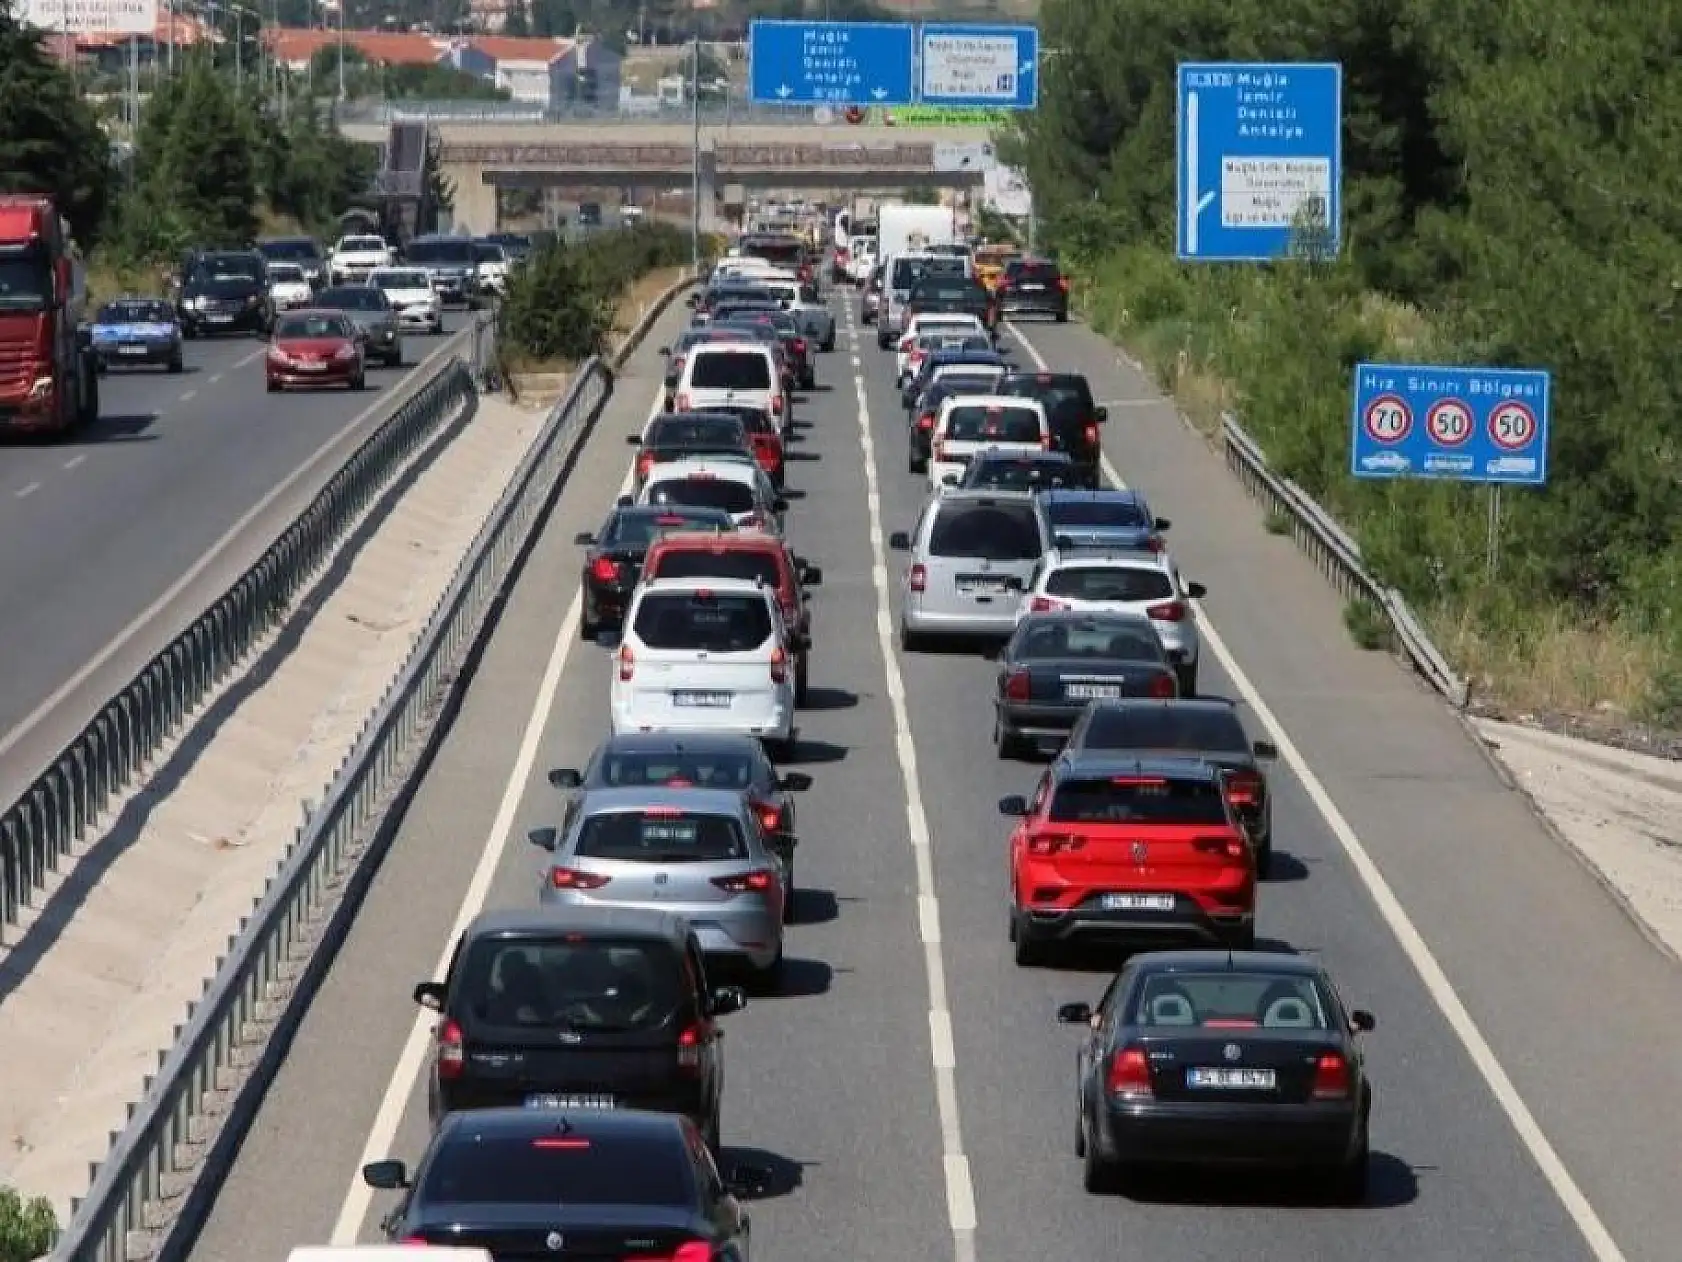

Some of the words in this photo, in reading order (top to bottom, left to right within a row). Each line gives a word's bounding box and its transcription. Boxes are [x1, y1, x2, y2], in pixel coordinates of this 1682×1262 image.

[1238, 105, 1296, 120] Denizli
[1239, 123, 1303, 139] Antalya
[1377, 408, 1403, 431] 70
[1437, 413, 1463, 435] 50
[1500, 415, 1527, 437] 50
